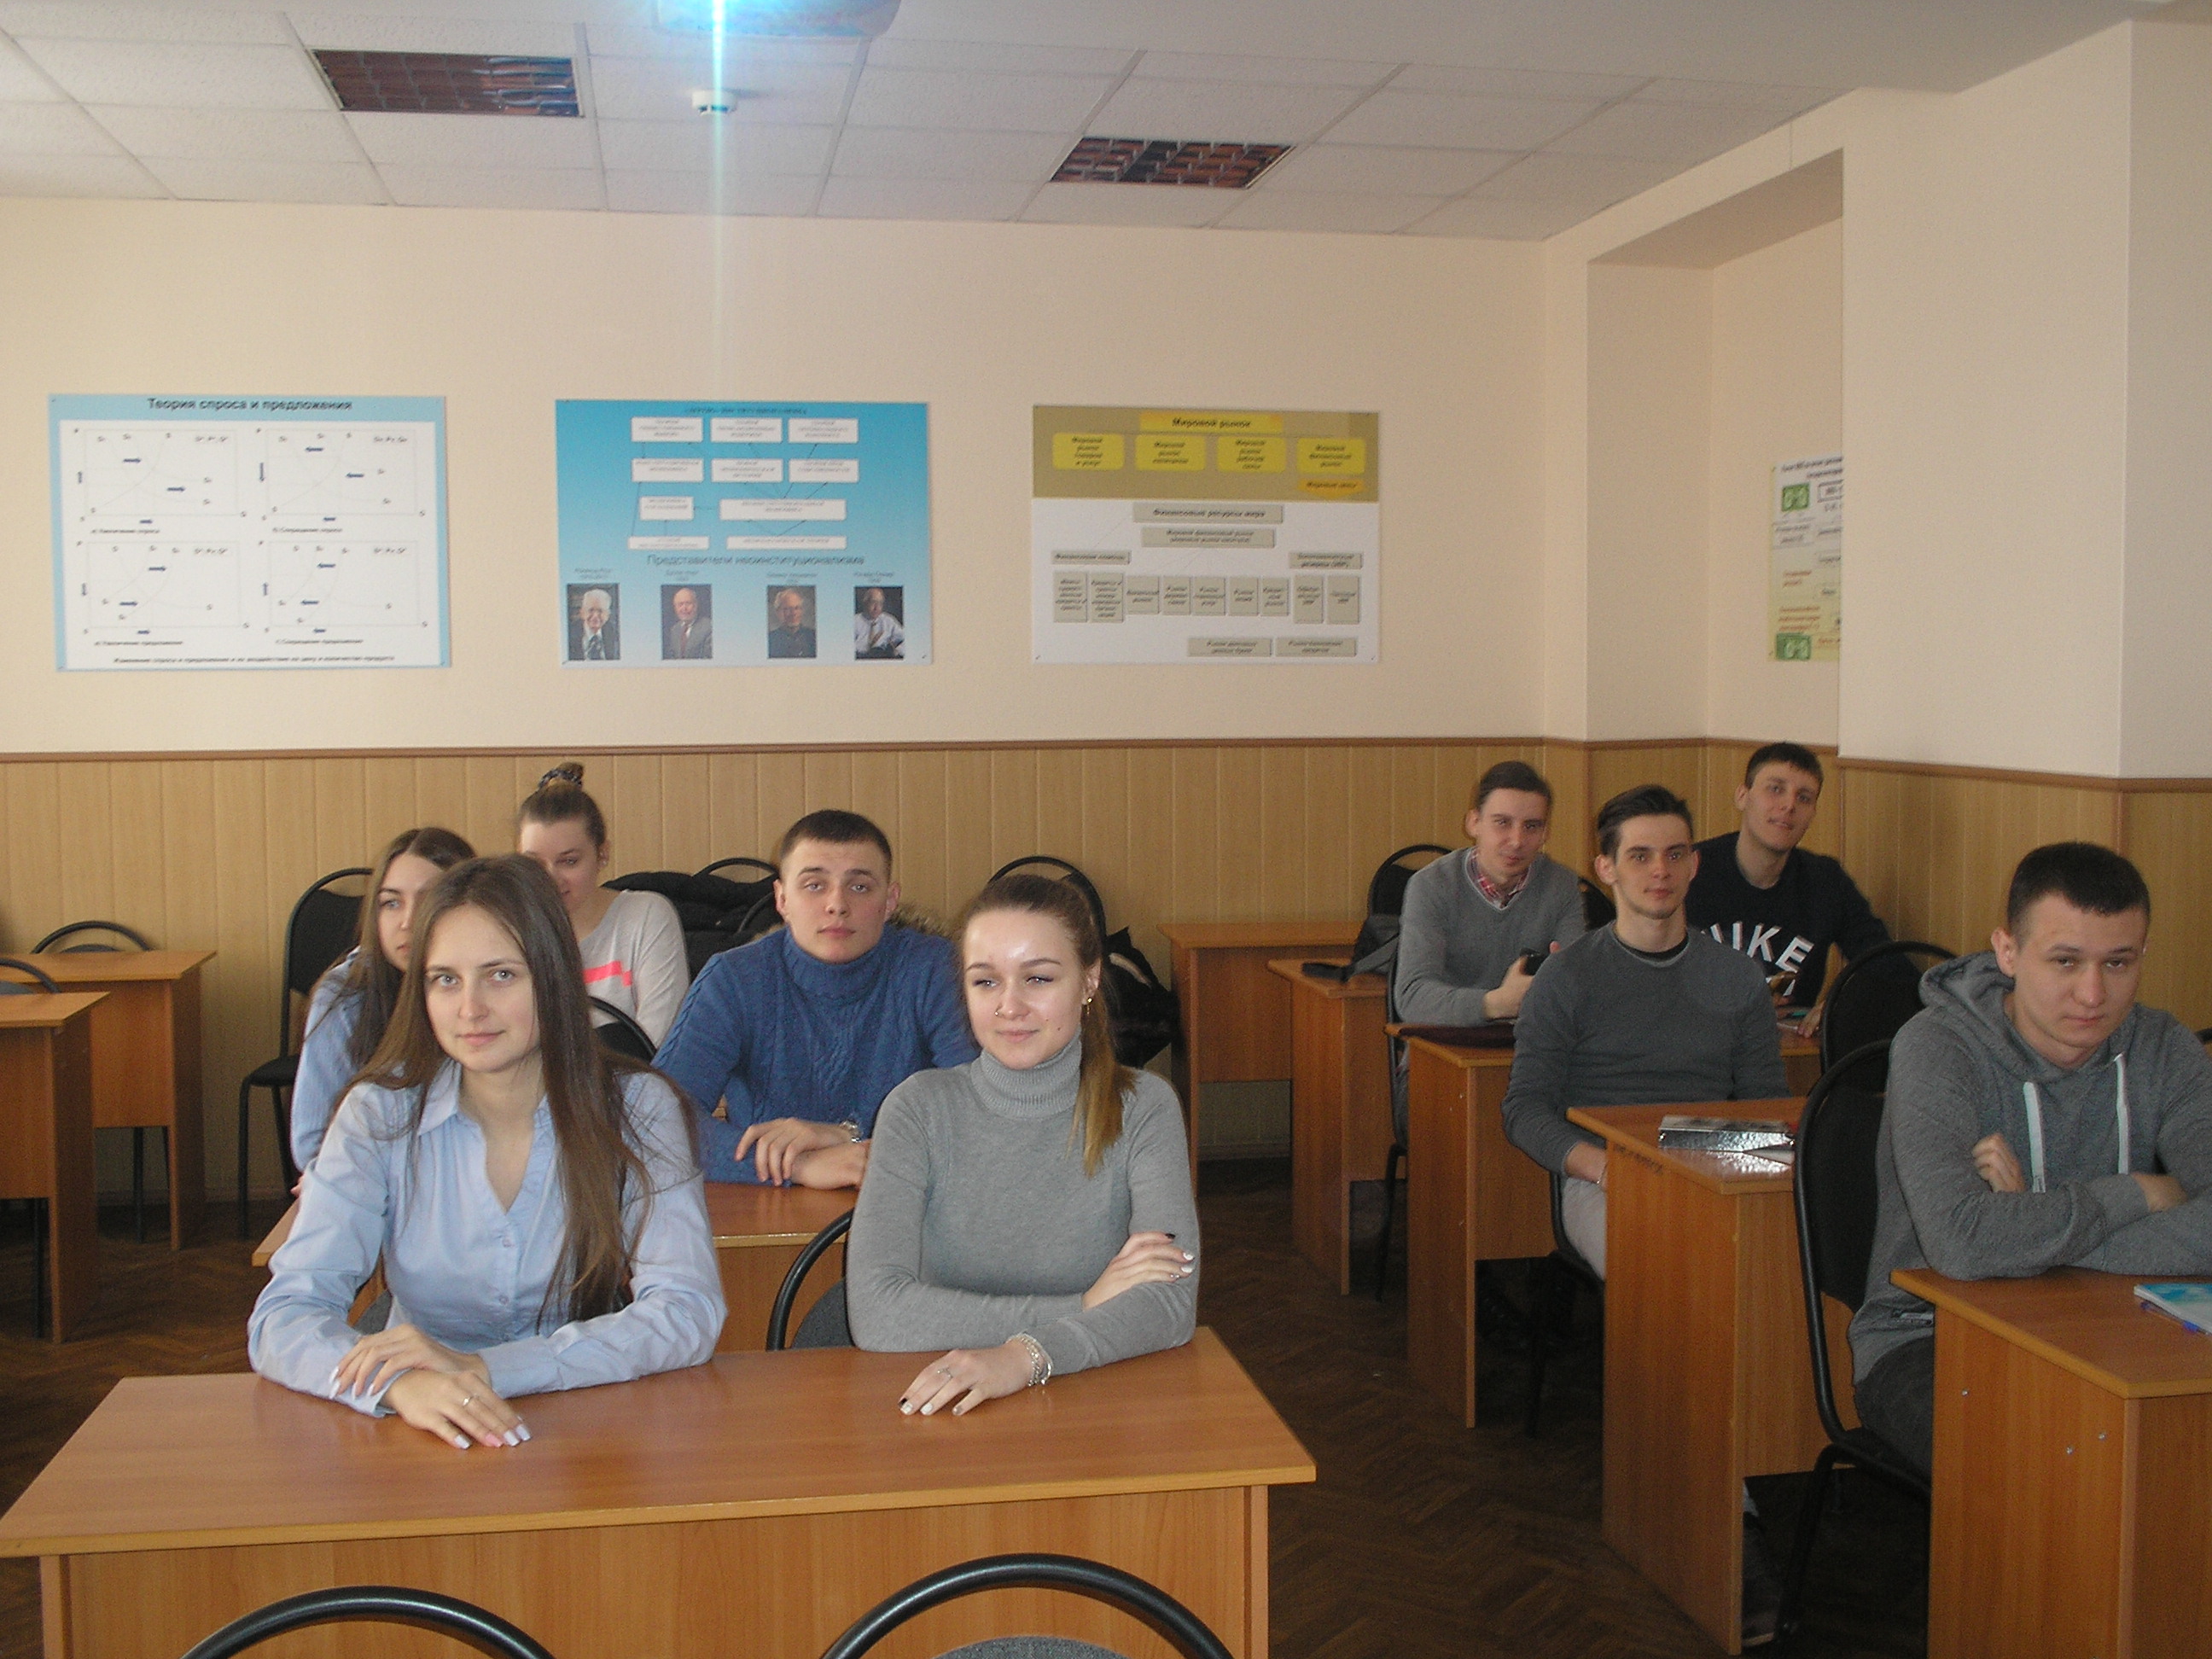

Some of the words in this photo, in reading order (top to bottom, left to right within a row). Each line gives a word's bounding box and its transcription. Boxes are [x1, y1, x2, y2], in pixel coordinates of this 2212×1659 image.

[148, 398, 196, 411] Теория
[199, 400, 247, 411] спроса
[250, 400, 259, 410] и
[262, 399, 352, 412] предложения
[1173, 417, 1216, 428] Мировой
[646, 555, 732, 567] Представители
[735, 556, 865, 568] неоинституционализма
